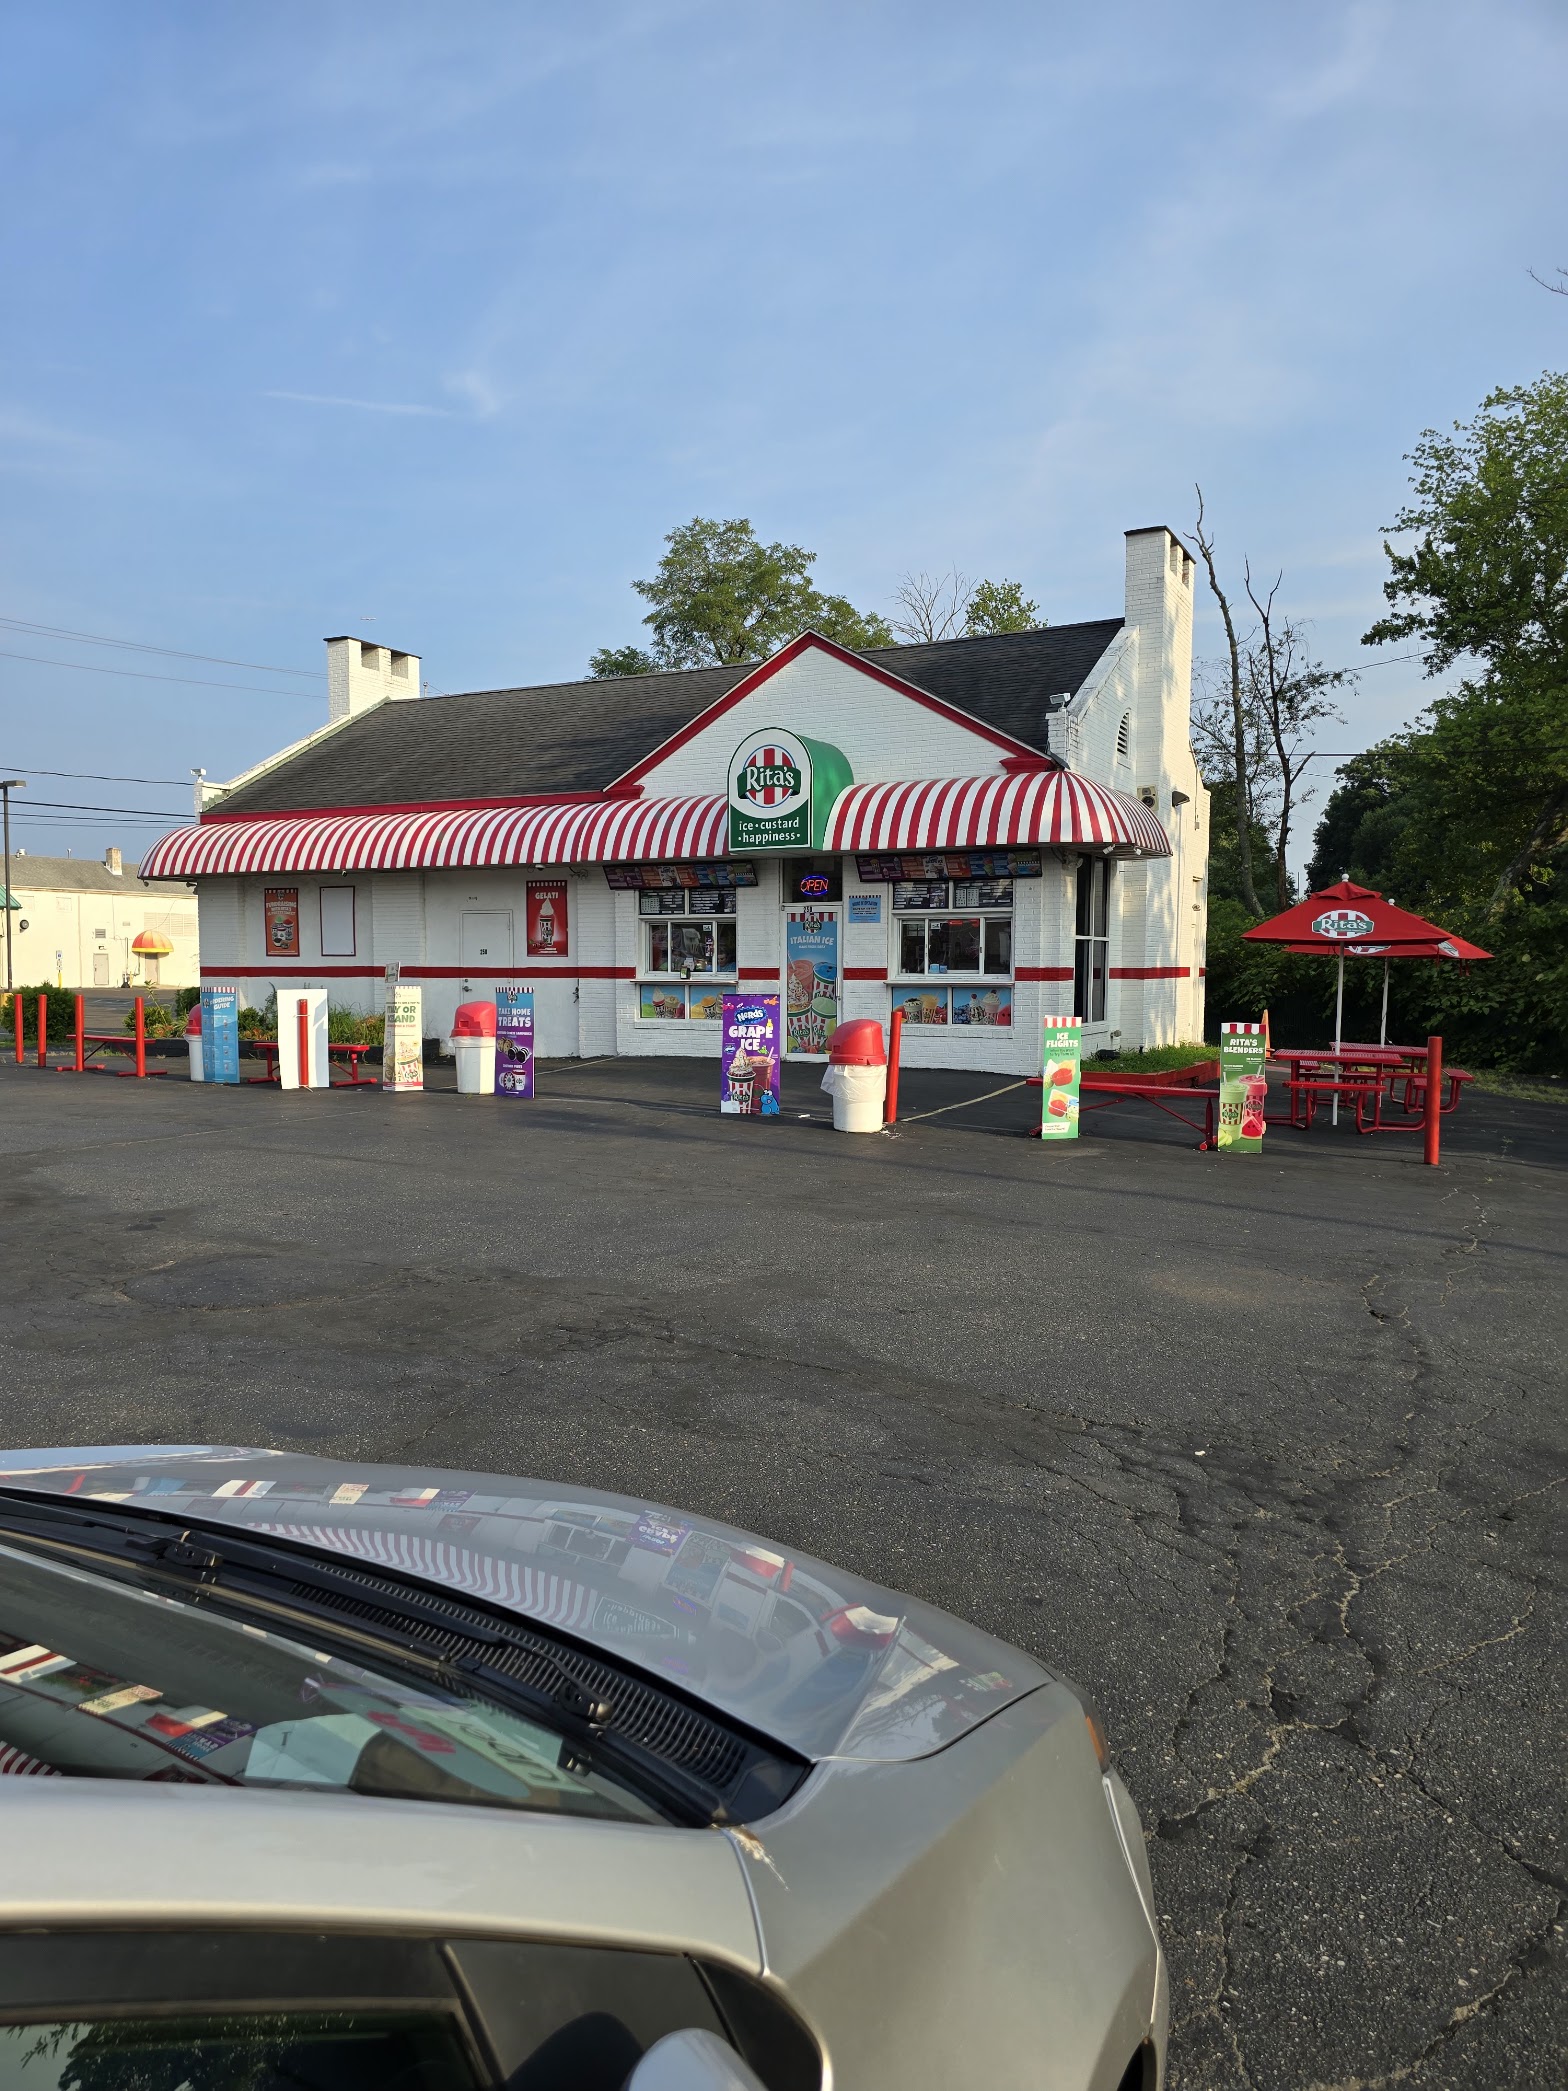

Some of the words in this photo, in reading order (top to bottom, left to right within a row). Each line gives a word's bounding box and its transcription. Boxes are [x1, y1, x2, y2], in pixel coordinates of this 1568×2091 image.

[745, 766, 795, 791] Rita's
[739, 821, 754, 831] ice
[760, 817, 800, 830] custard
[742, 831, 796, 845] happiness
[800, 879, 829, 892] OPEN
[1321, 918, 1368, 931] Rita's
[790, 935, 821, 945] ITALIAN
[821, 936, 834, 946] ICE
[498, 1017, 532, 1028] TREATS
[728, 1025, 773, 1039] GRAPE
[1056, 1032, 1069, 1040] ICE
[740, 1039, 761, 1051] ICE
[1046, 1040, 1079, 1049] FLIGHTS
[1229, 1038, 1258, 1047] RITA'S
[1223, 1046, 1264, 1054] BLENDERS
